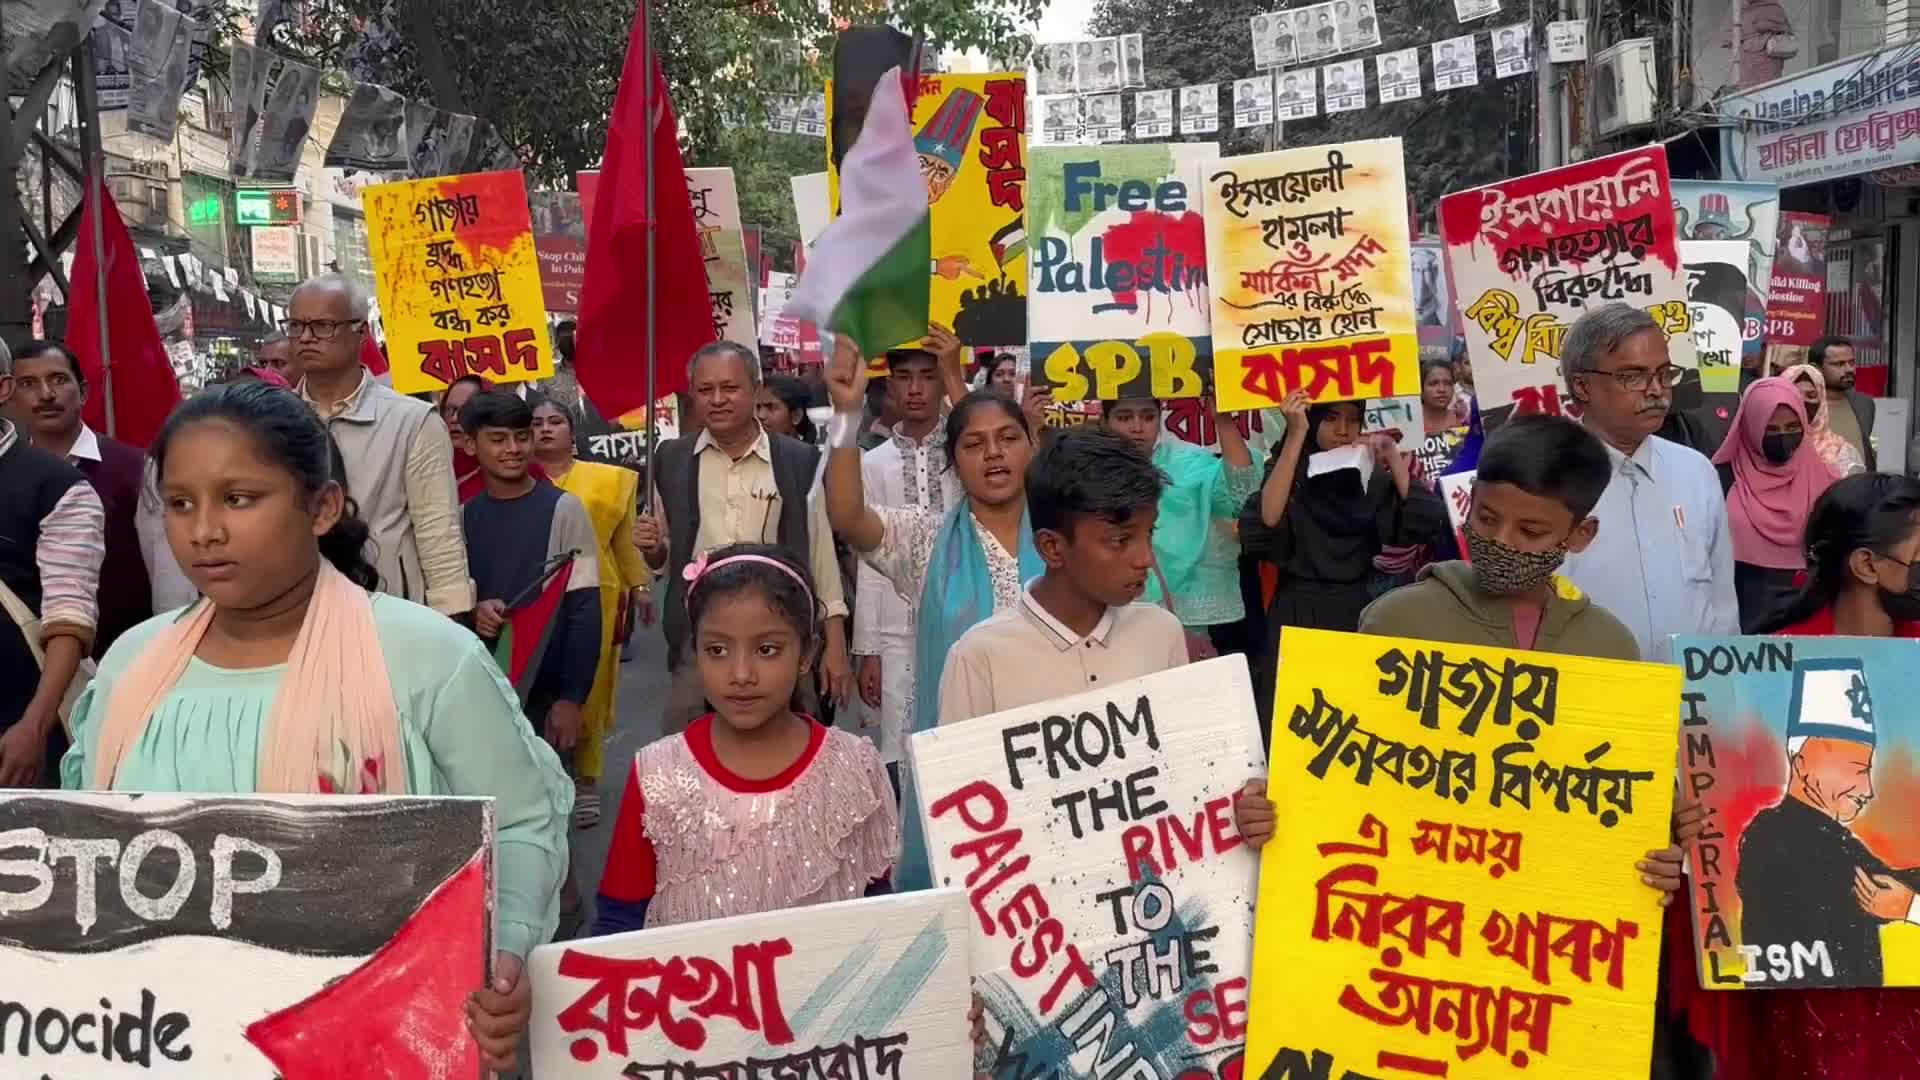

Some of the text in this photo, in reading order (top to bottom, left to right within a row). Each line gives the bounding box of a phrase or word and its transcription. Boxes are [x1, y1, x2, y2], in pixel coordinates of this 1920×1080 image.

[1754, 87, 1826, 136] Hasina
[1758, 129, 1829, 171] হাসিনা
[415, 193, 480, 233] গাজায়
[1063, 160, 1187, 213] Free
[1262, 206, 1354, 250] হামলা
[1501, 213, 1656, 275] গণহত্যার
[430, 268, 506, 304] গণহত্যা
[1031, 236, 1209, 294] Palestin
[1239, 252, 1331, 294] মার্কিন
[1788, 276, 1821, 293] Killing
[475, 303, 512, 328] কর
[417, 328, 539, 385] বাসদ
[1043, 331, 1203, 400] SPB
[1240, 338, 1396, 404] বাসদ
[1375, 647, 1559, 741] গাজায়
[1682, 642, 1793, 682] DOWN
[1001, 694, 1161, 790] FROM
[1288, 688, 1655, 828] মানবতার বিপর্যয়
[1051, 765, 1169, 839] THE
[1121, 789, 1245, 883] RIVE
[1317, 813, 1524, 880] এ সময়
[0, 826, 283, 936] STOP
[1096, 881, 1175, 937] TO
[1311, 863, 1640, 990] নিরব থাকা
[557, 937, 796, 1062] রুখো
[1105, 924, 1220, 1010] THE
[0, 988, 193, 1068] nocide
[1182, 975, 1248, 1048] SE
[1337, 967, 1574, 1070] অন্যায়
